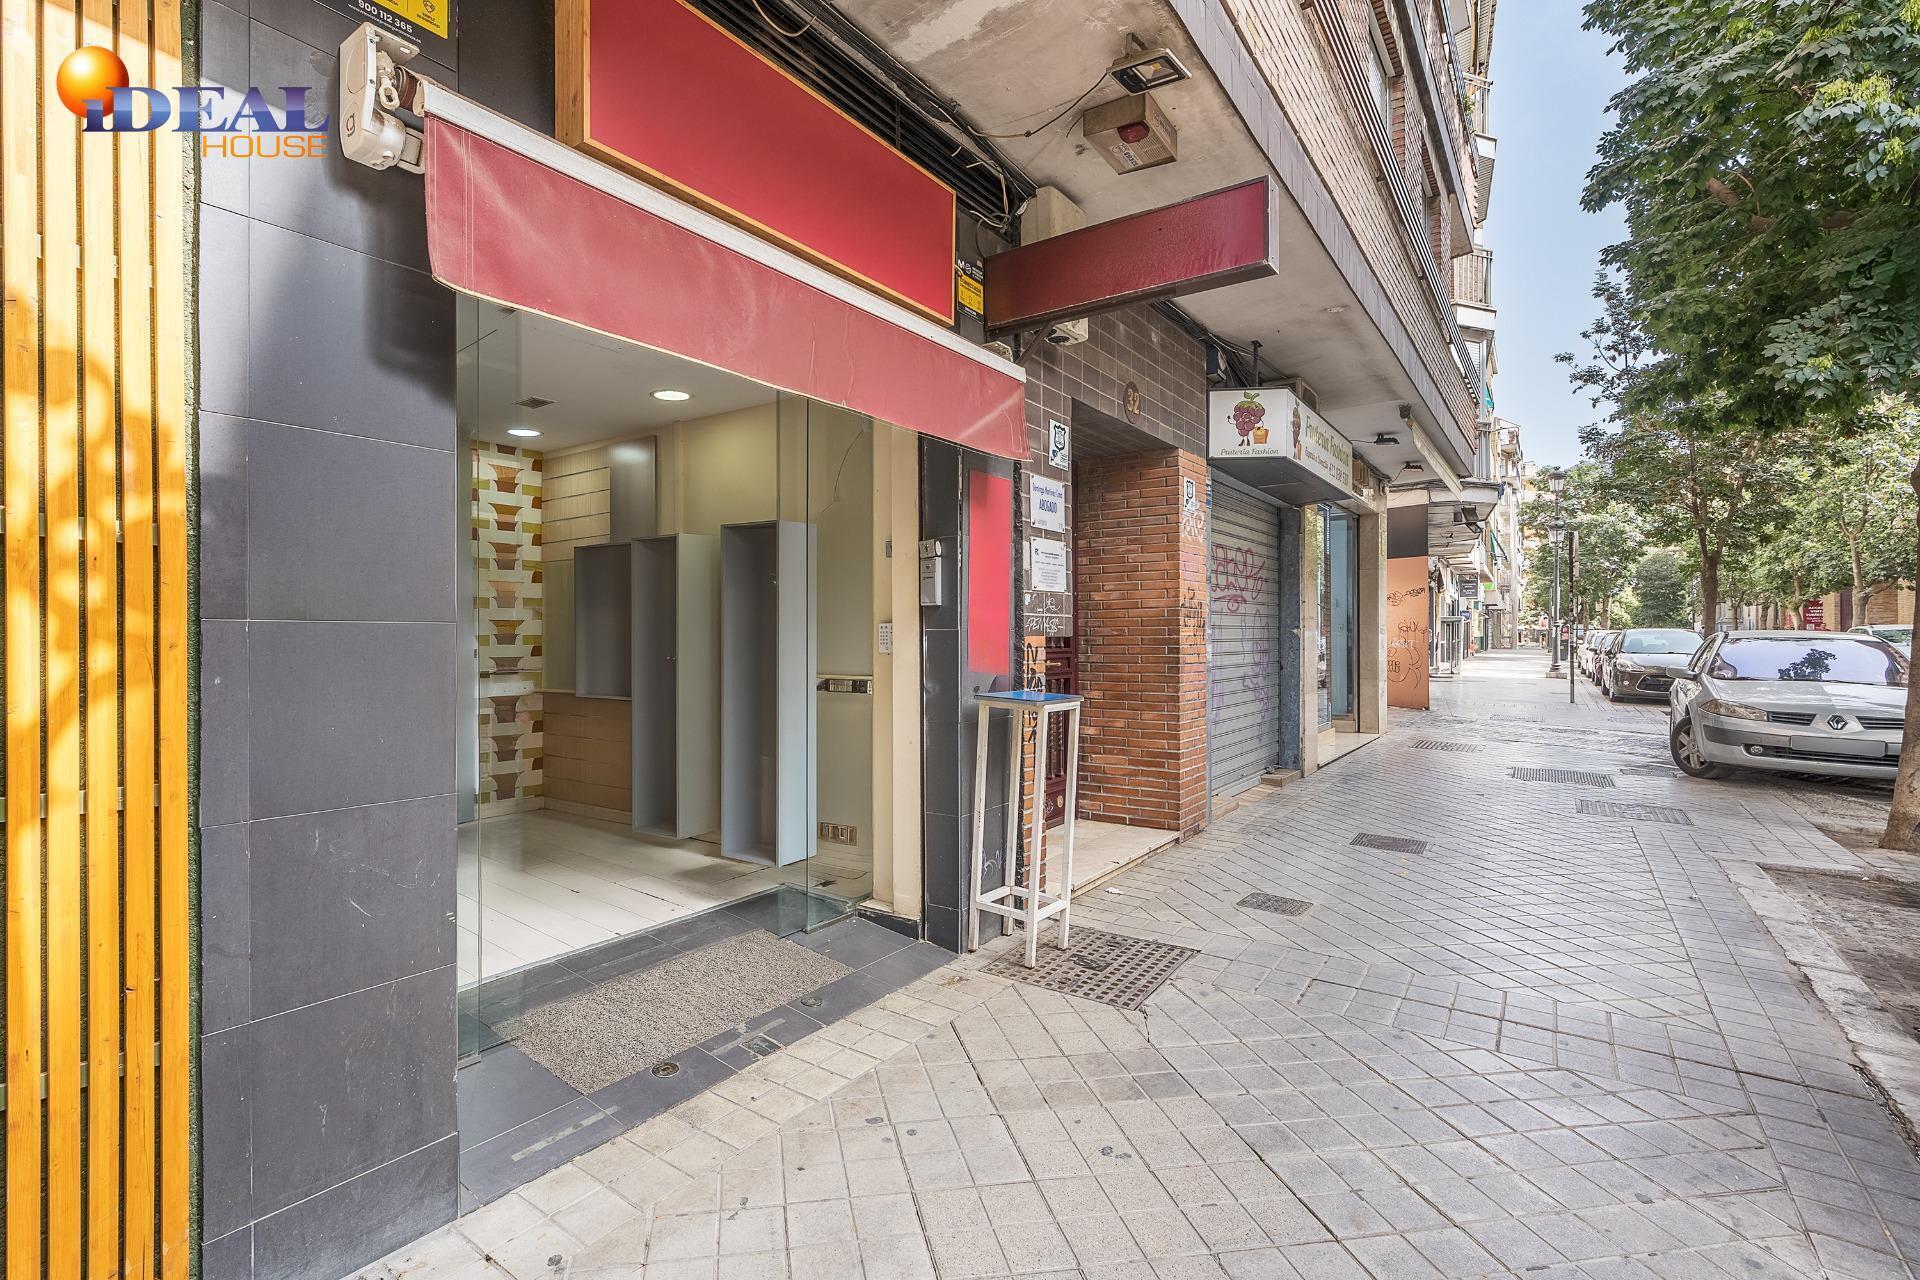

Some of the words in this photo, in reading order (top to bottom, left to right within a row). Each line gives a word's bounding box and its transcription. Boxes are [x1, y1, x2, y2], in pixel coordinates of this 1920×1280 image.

[358, 0, 378, 14] 900
[379, 10, 393, 23] 112
[395, 18, 413, 33] 365
[1127, 388, 1140, 415] 32
[1251, 447, 1279, 455] Fashion
[1039, 498, 1058, 514] ABOGADO
